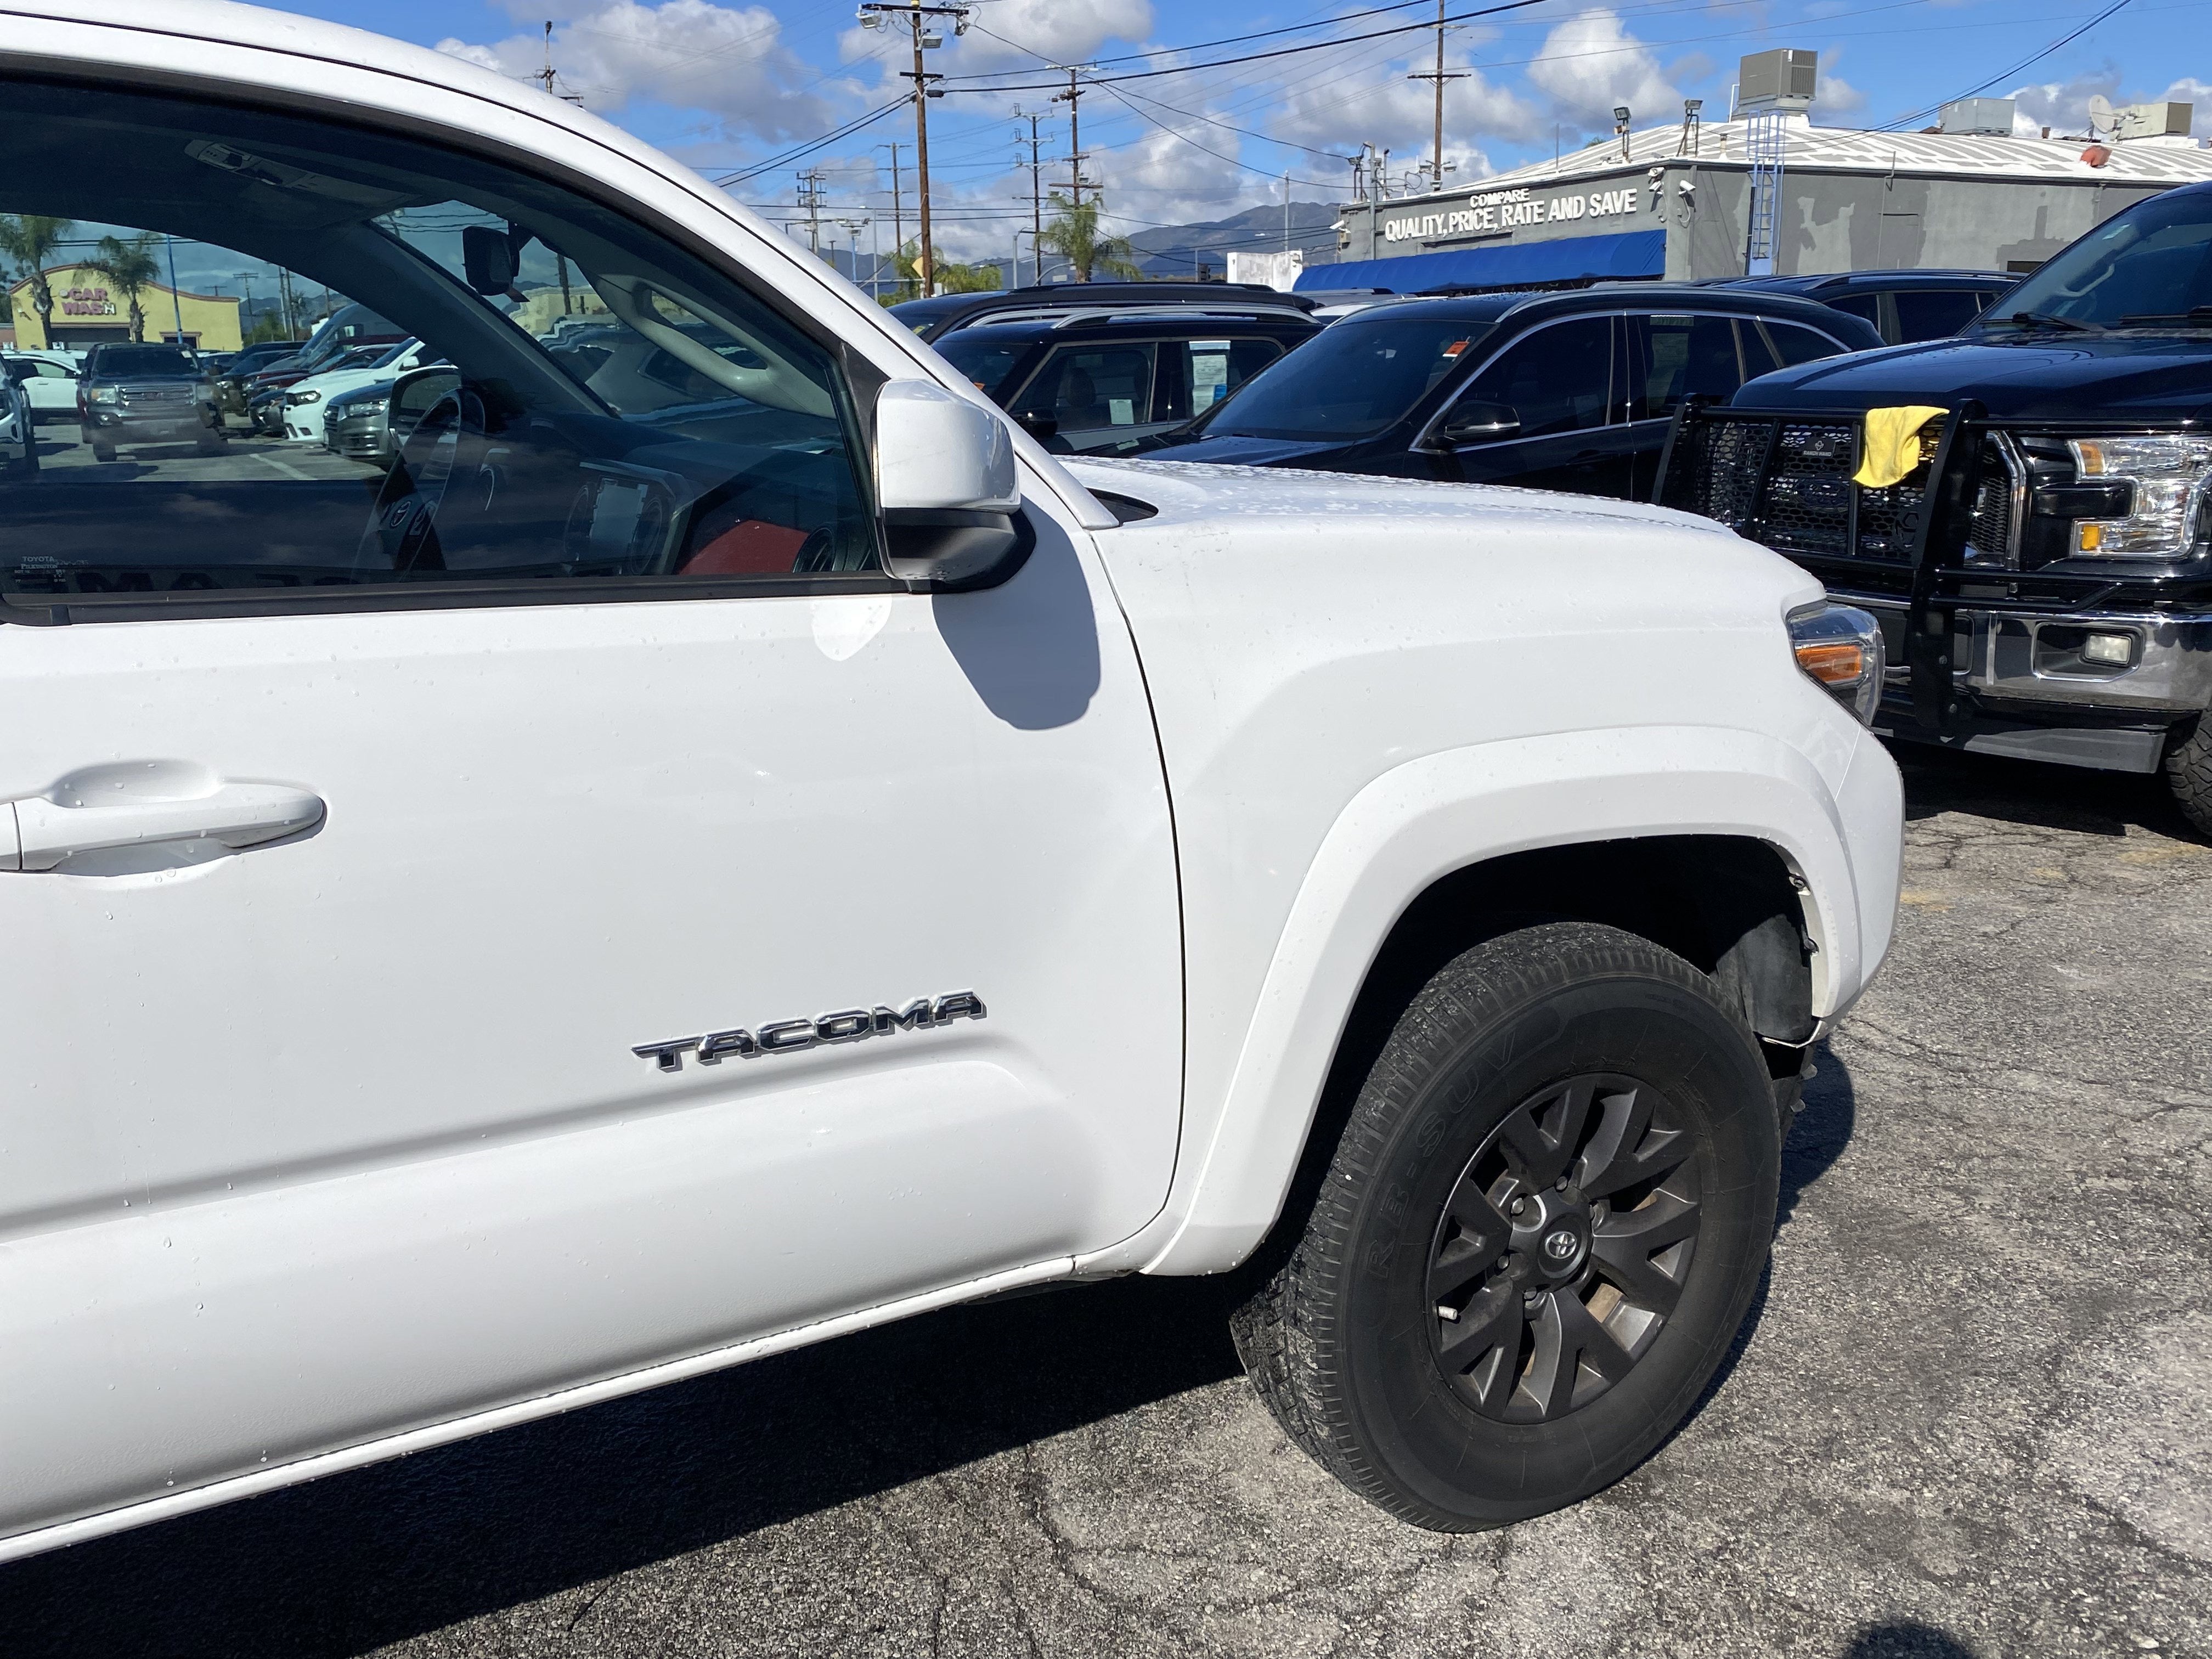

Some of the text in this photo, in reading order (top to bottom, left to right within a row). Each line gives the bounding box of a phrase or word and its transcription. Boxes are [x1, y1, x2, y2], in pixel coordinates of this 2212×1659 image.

[1470, 188, 1530, 208] COMPARE
[1385, 188, 1637, 242] QUALITY, PRICE, RATE AND SAVE
[69, 288, 108, 301] CAR
[61, 302, 116, 315] WASH
[631, 988, 986, 1072] TACOMA
